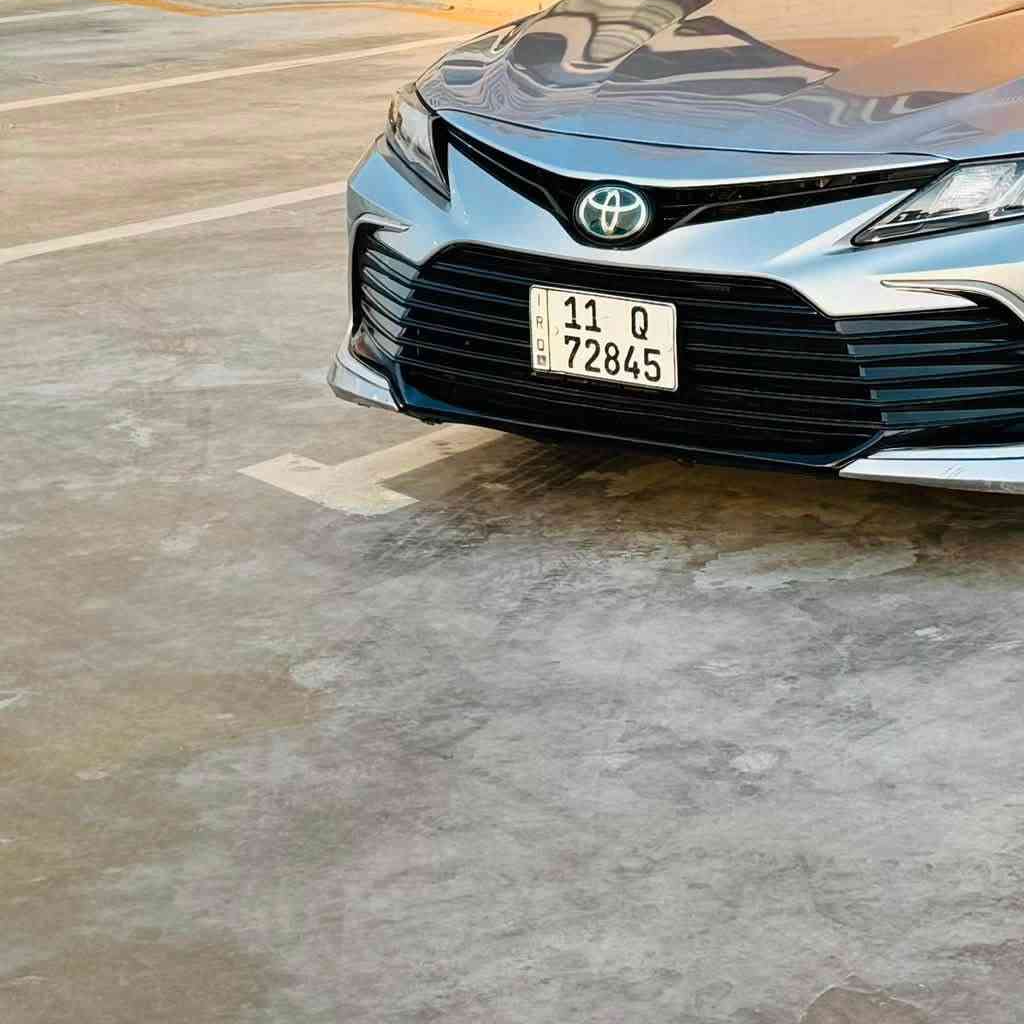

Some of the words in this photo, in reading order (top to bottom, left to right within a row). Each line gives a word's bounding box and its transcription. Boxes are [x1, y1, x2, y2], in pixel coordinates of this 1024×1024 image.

[564, 296, 601, 333] 11
[631, 305, 649, 341] Q
[564, 334, 662, 383] 72845
